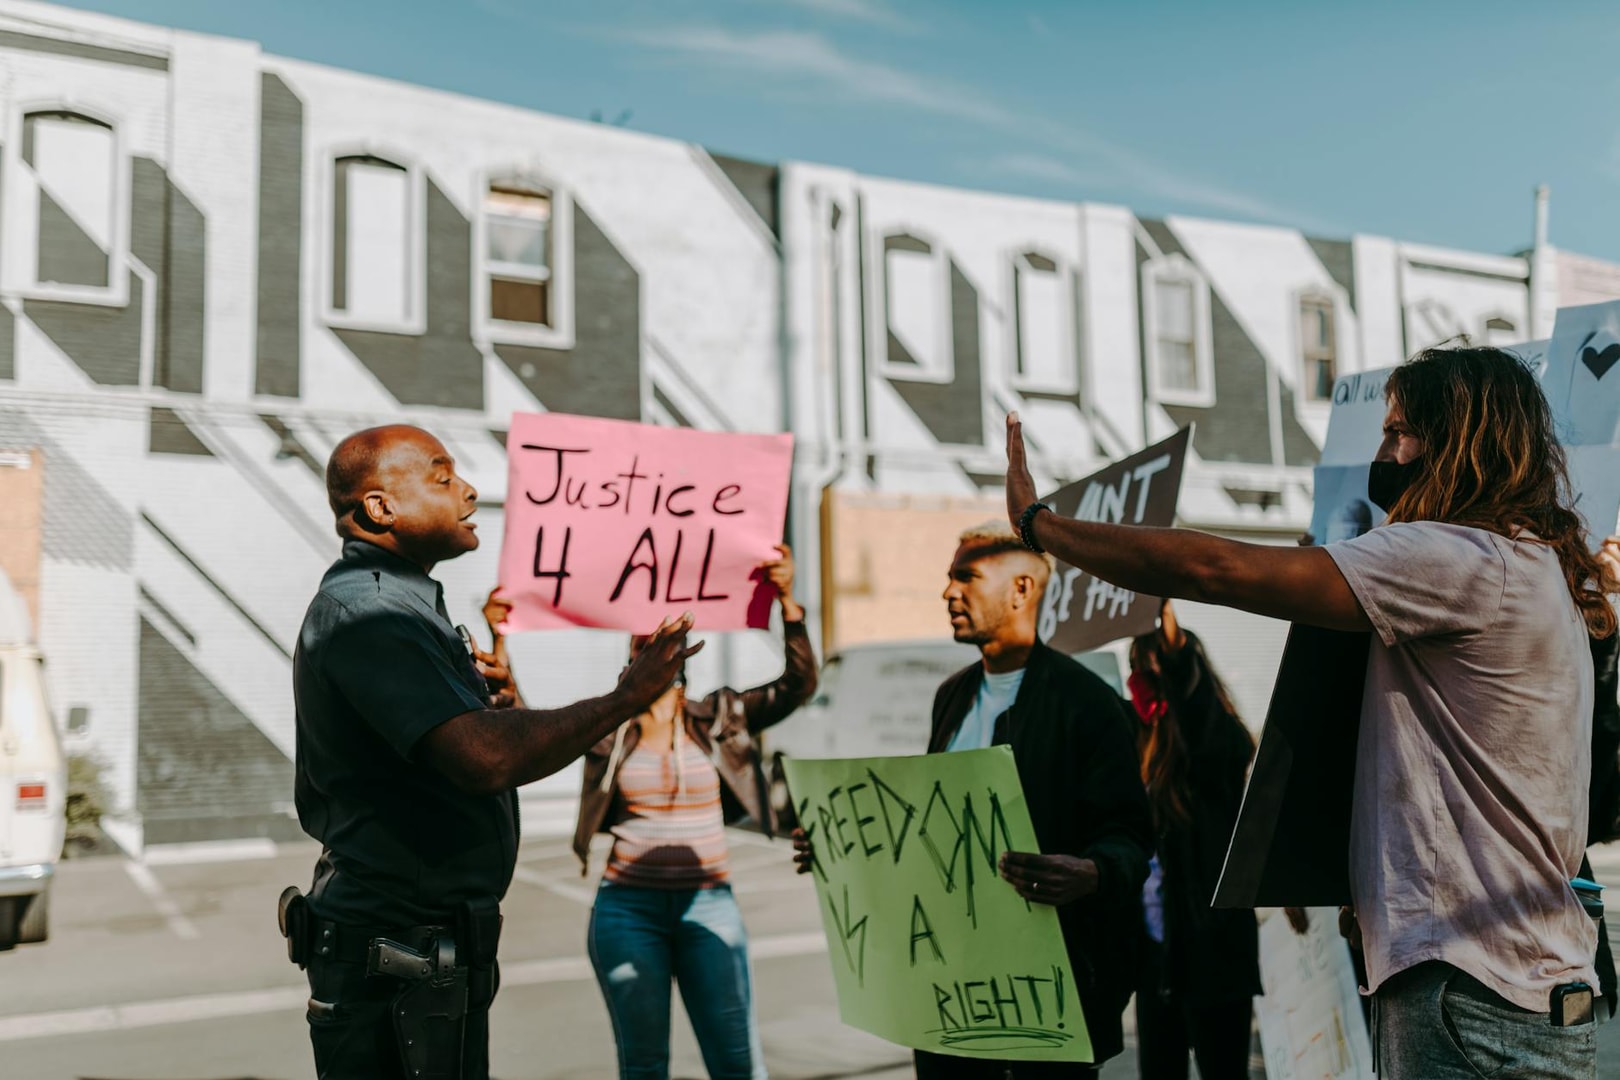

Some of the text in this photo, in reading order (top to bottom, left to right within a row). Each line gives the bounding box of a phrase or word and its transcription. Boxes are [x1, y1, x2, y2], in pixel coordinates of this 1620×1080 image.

[521, 443, 744, 517] Justice
[533, 526, 729, 608] 4 ALL
[799, 767, 1031, 930] FREEDOM
[909, 894, 947, 968] A
[932, 964, 1064, 1032] RIGHT!
